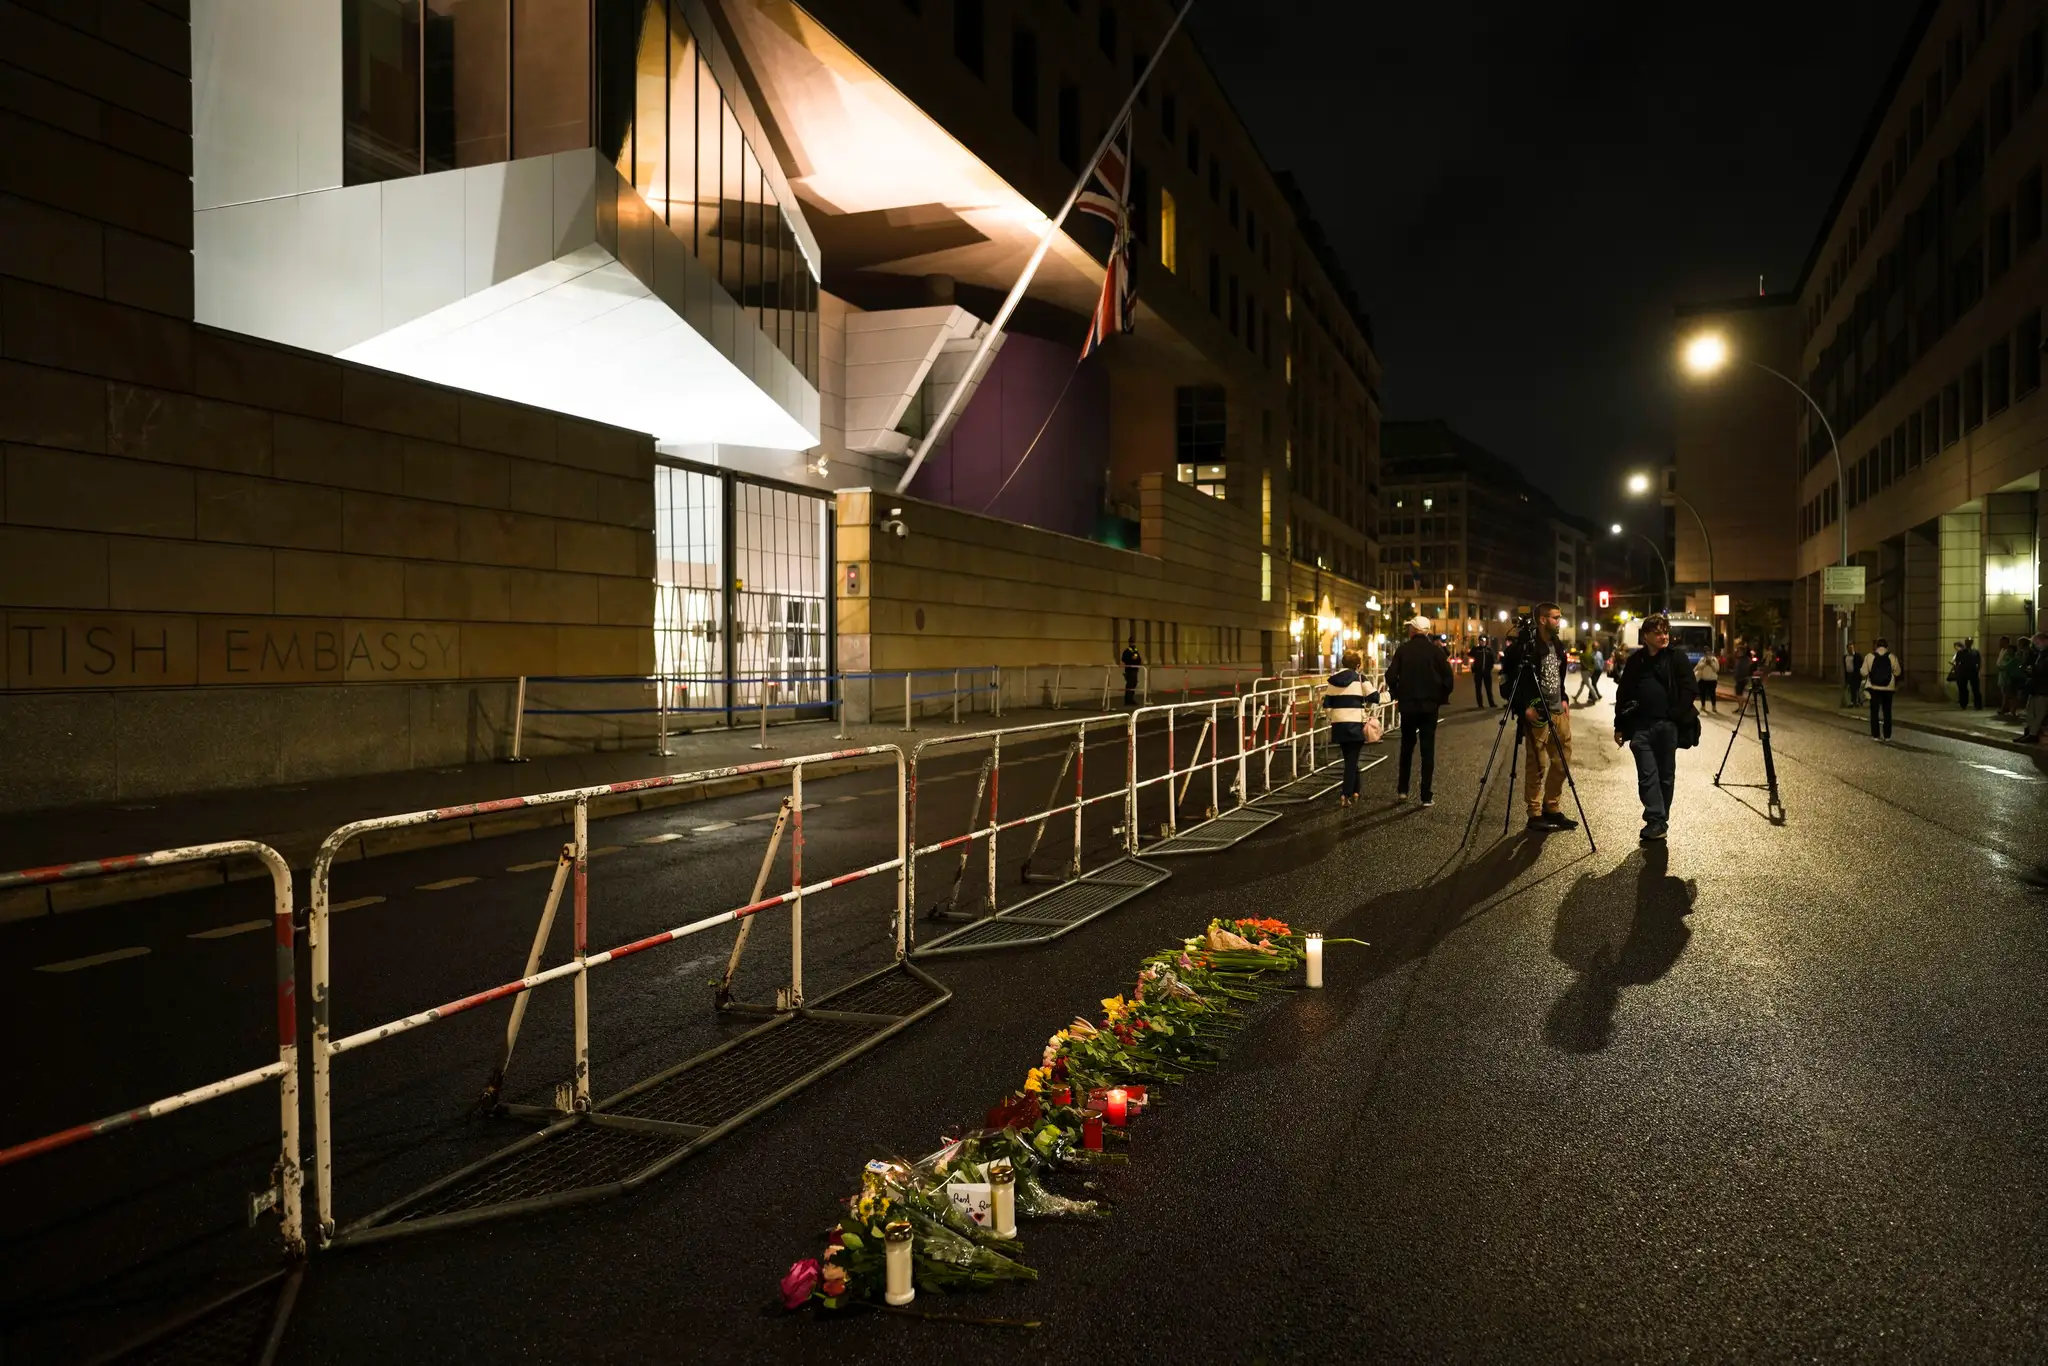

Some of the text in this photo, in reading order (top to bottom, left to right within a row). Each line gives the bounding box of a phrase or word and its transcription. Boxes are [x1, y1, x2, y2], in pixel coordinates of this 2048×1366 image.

[11, 624, 456, 676] TISH EMBASSY
[953, 1192, 970, 1204] Rest
